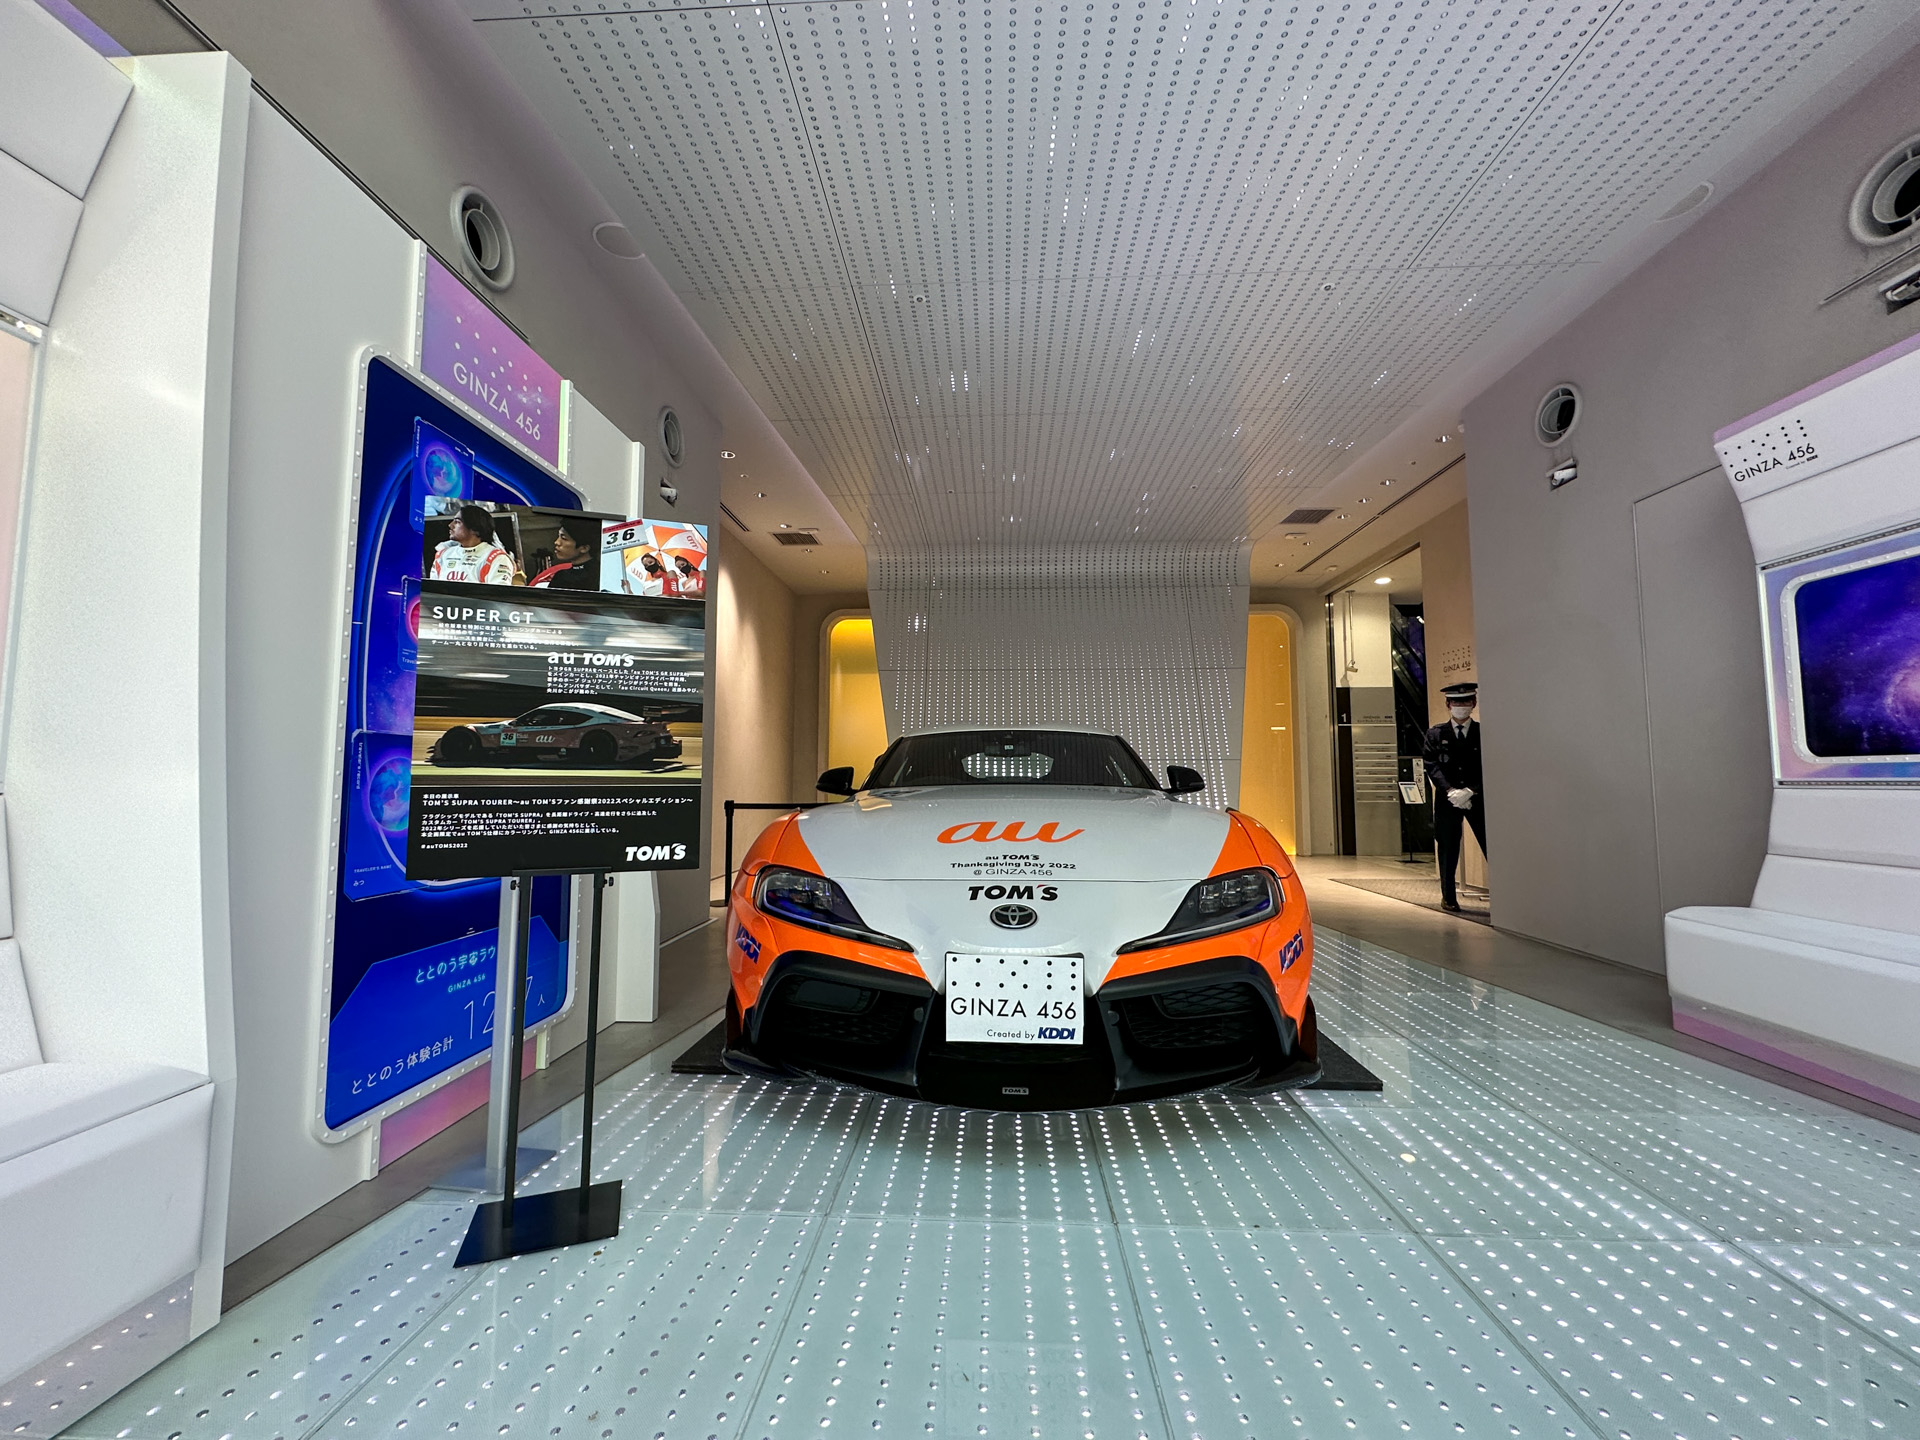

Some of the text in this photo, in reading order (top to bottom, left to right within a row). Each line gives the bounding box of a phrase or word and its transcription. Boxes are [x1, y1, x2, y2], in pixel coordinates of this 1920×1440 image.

[453, 362, 541, 440] GINZA 456
[1734, 457, 1783, 482] GINZA
[1788, 443, 1815, 461] 456
[606, 528, 635, 545] 36
[446, 570, 468, 581] au
[432, 606, 534, 624] SUPER GT
[547, 652, 635, 667] au TOM'S
[1443, 663, 1460, 673] GINZA
[1461, 661, 1471, 669] 456
[1341, 713, 1347, 723] 1
[535, 735, 556, 743] au
[937, 821, 1085, 844] au
[625, 843, 687, 861] TOM'S
[985, 868, 1027, 876] GINZA
[1048, 862, 1077, 870] 2022
[967, 884, 1058, 901] TOM'S
[736, 922, 762, 964] KDDI
[1279, 929, 1304, 975] KDDI
[415, 946, 497, 983] ととのう宇宙ラウ
[447, 973, 486, 993] GINZA 456
[950, 997, 1077, 1019] GINZA 456
[986, 1027, 1076, 1041] Created by KDDI
[351, 1035, 454, 1095] ととのう体験合計
